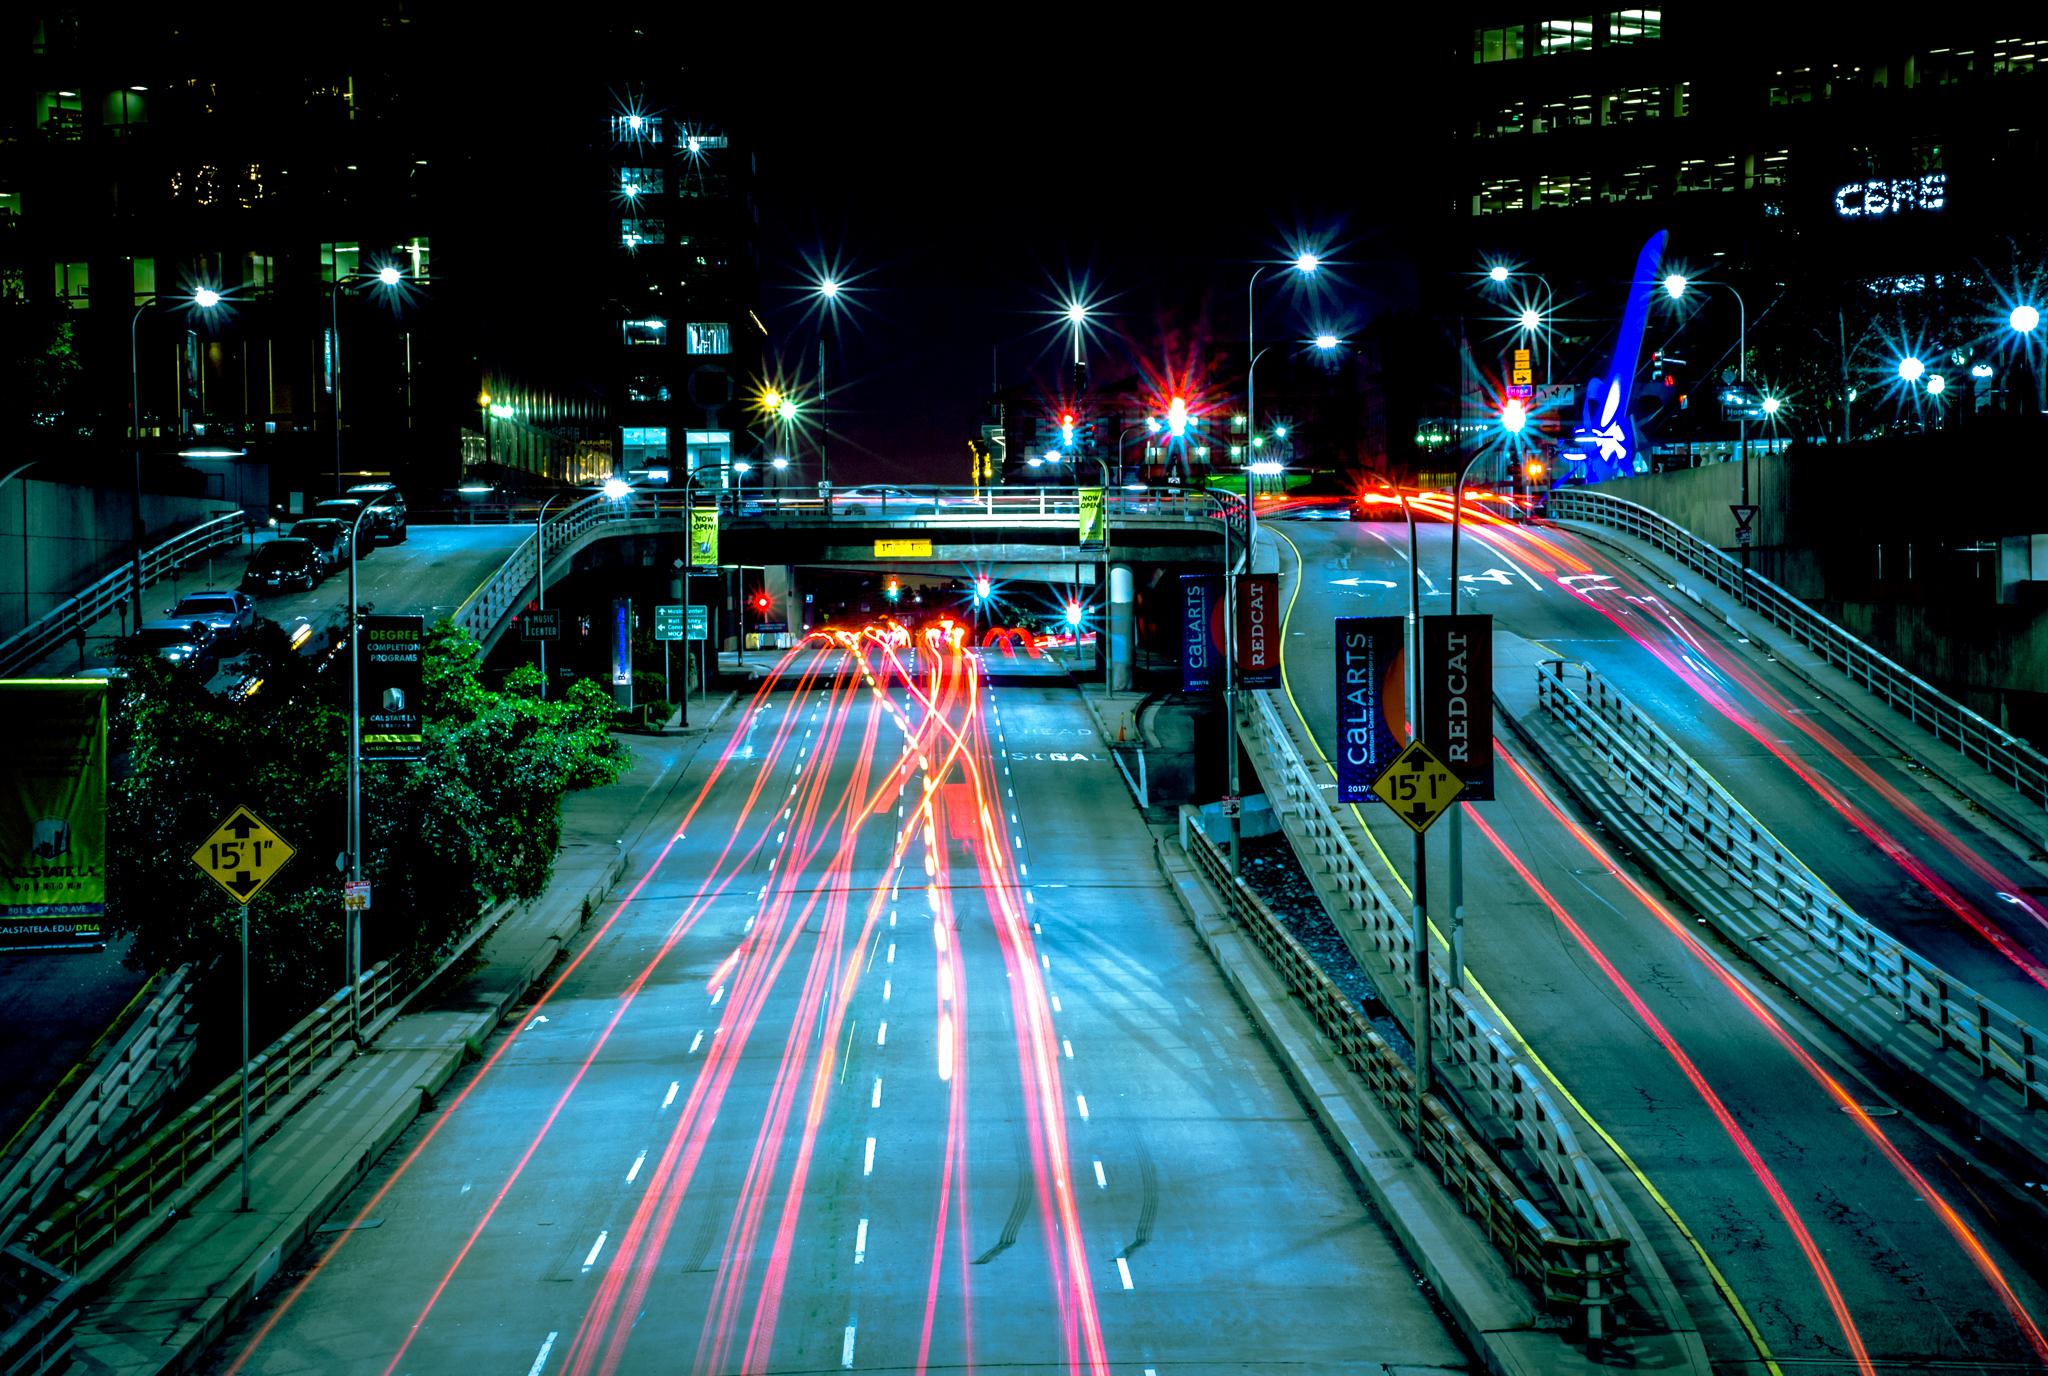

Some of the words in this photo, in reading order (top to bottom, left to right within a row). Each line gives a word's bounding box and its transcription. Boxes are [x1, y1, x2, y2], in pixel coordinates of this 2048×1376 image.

[533, 615, 554, 623] MUSIC
[1250, 583, 1265, 666] REDCAT
[370, 630, 419, 641] DEGREE
[531, 626, 557, 636] CENTER
[367, 643, 421, 651] COMPLETION
[370, 654, 418, 662] PROGRAMS
[1448, 631, 1468, 762] REDCAT
[1389, 774, 1420, 801] 15'
[1429, 773, 1447, 800] 1"
[210, 842, 245, 870] 15'
[253, 840, 273, 867] 1"
